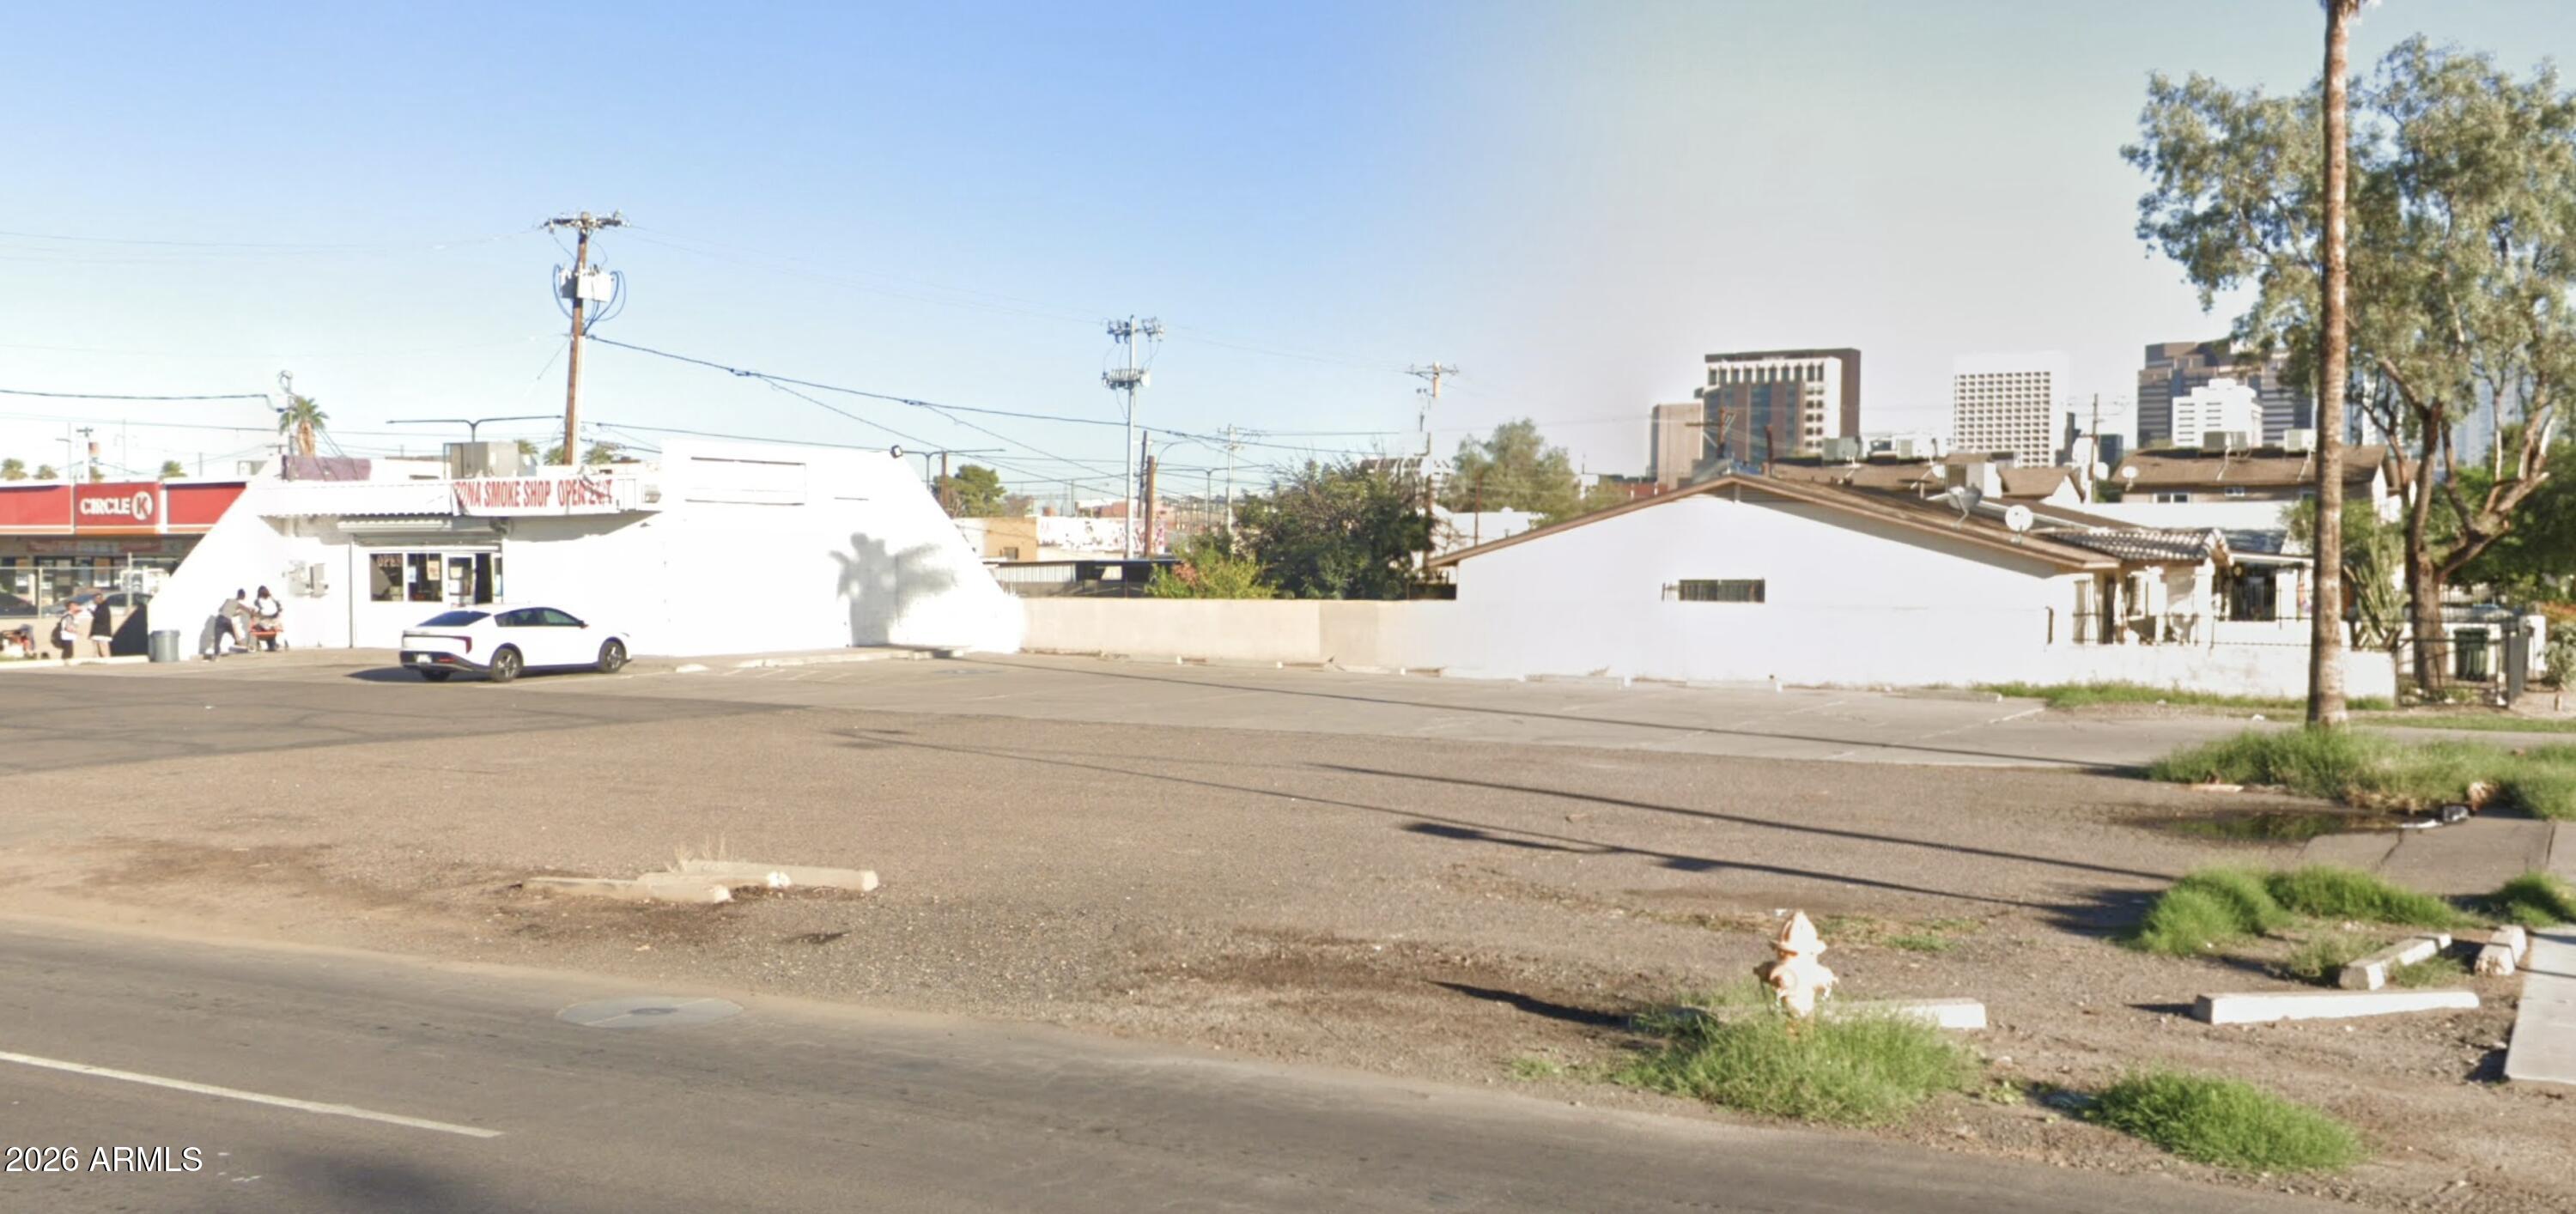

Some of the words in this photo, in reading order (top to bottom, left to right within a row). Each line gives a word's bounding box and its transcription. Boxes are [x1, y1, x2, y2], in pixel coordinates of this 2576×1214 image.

[484, 480, 520, 507] SMOKE
[524, 480, 551, 507] SHOP
[557, 479, 586, 507] OPEN
[80, 497, 131, 515] CIRCLE
[135, 495, 150, 519] K
